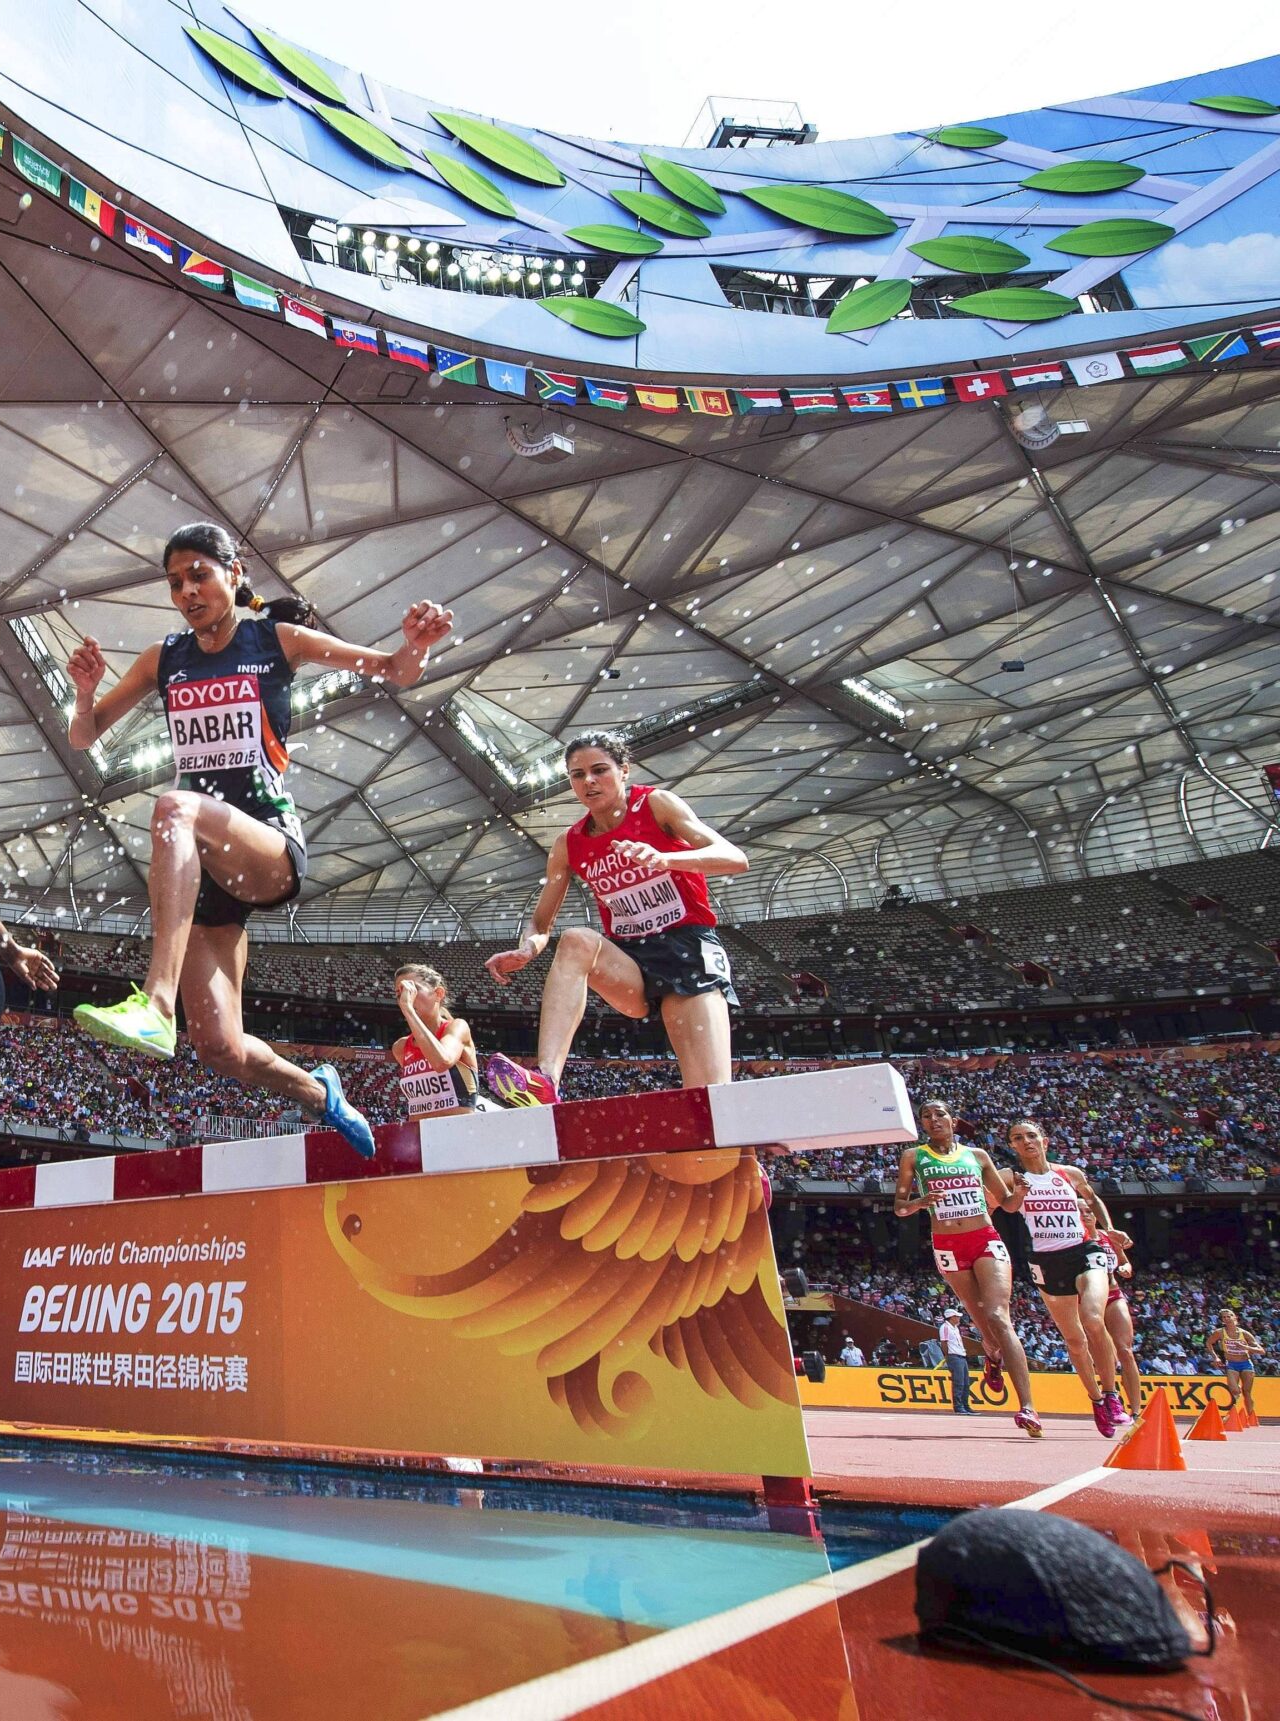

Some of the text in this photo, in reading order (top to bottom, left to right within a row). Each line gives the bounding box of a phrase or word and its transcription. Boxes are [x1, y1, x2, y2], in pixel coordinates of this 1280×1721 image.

[237, 664, 270, 674] INDIA
[170, 679, 256, 708] TOYOTA
[173, 711, 255, 746] BABAR
[179, 749, 257, 770] BEIJING 2015
[586, 853, 630, 880] MARO
[638, 880, 678, 911] ALAMI
[614, 908, 681, 935] BEIJING 2015
[401, 1074, 451, 1100] KRAUSE
[409, 1097, 455, 1114] BEIJING 2015
[923, 1165, 978, 1177] ETHIOPIA
[928, 1177, 980, 1191] TOYOTA
[939, 1209, 969, 1220] BEIJING
[1025, 1201, 1076, 1211] TOYOTA
[1033, 1215, 1077, 1229] KAYA
[1066, 1231, 1084, 1239] 2015
[22, 1235, 247, 1269] IAAF World Championships
[939, 1253, 950, 1268] 5
[18, 1280, 248, 1335] BEIJING 2015
[14, 1350, 249, 1393] 国际田联世界田径锦标赛
